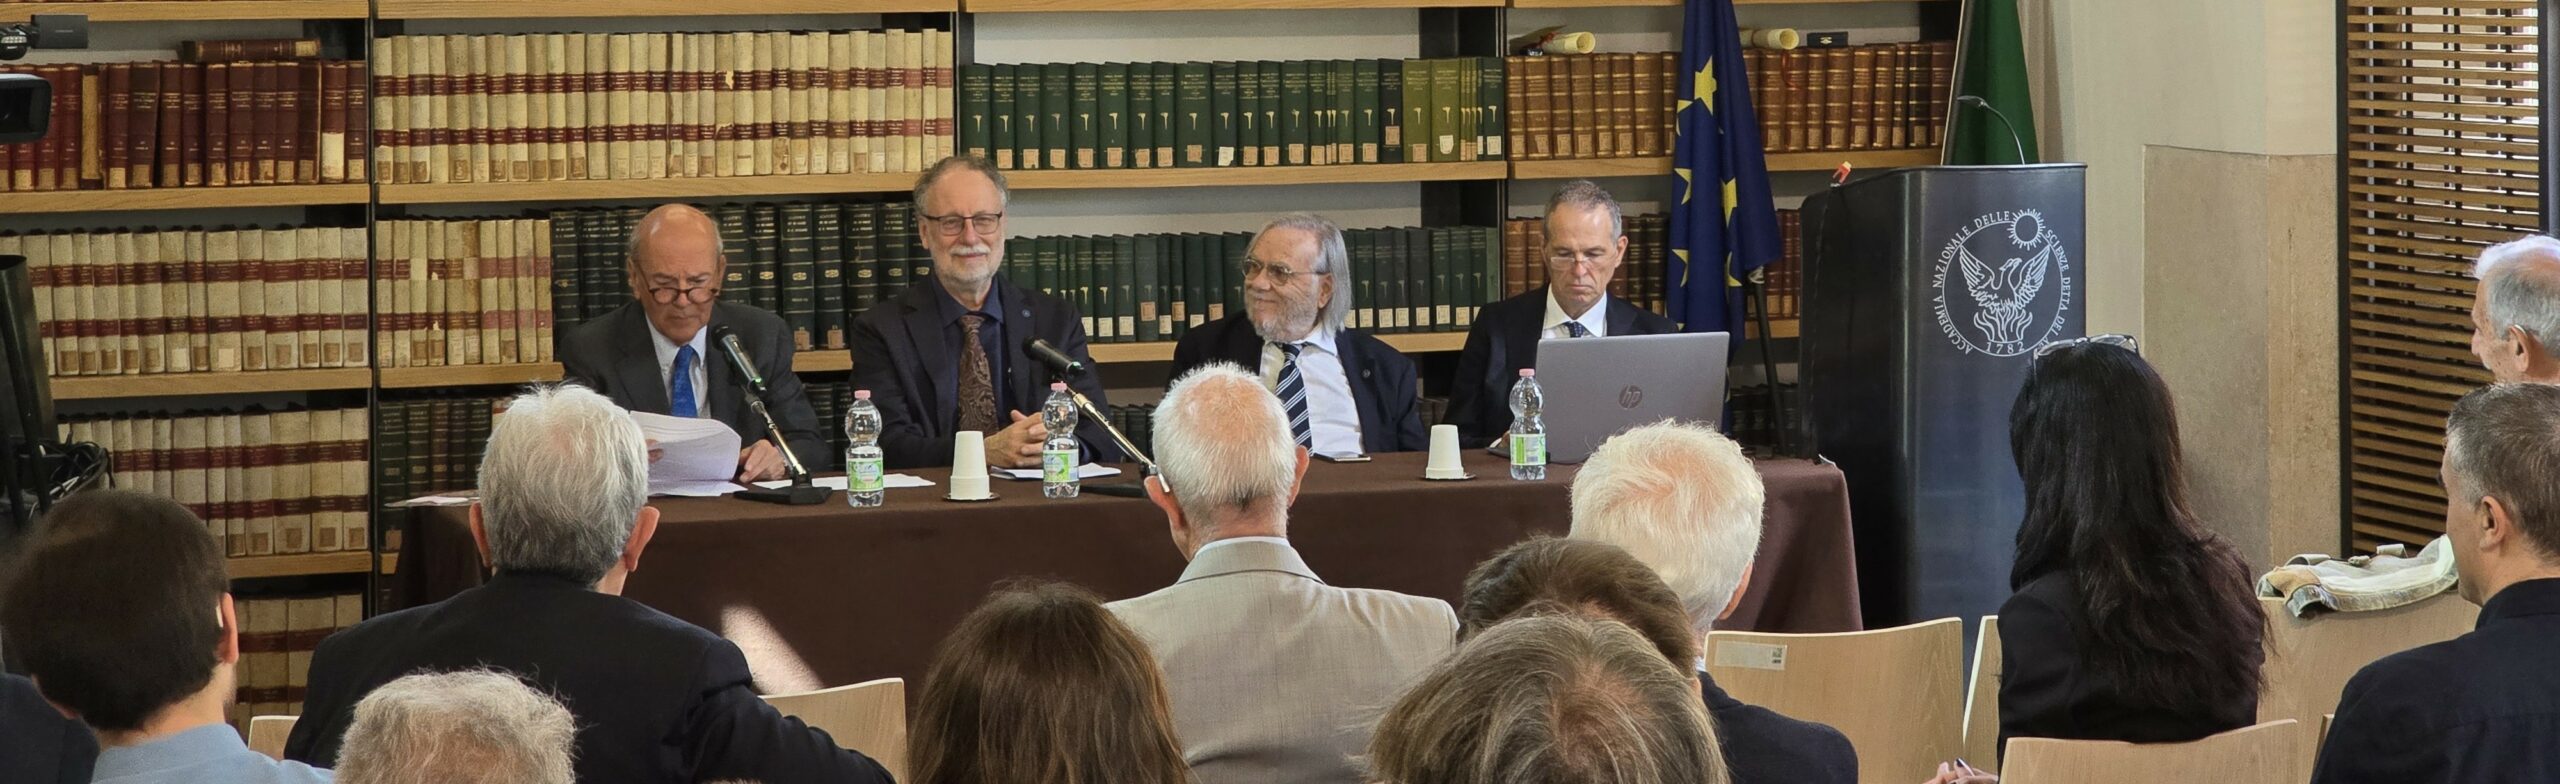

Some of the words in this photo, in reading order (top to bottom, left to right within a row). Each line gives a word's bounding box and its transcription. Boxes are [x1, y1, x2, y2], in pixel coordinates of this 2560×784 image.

[1974, 211, 2010, 228] DELLE
[1933, 225, 1971, 288] NAZIONALE
[2045, 229, 2069, 272] SCIENZE
[2061, 277, 2071, 312] DETTA
[1933, 298, 1973, 355] ACCADEMIA
[1986, 341, 2025, 355] 1782
[1619, 384, 1642, 409] hp
